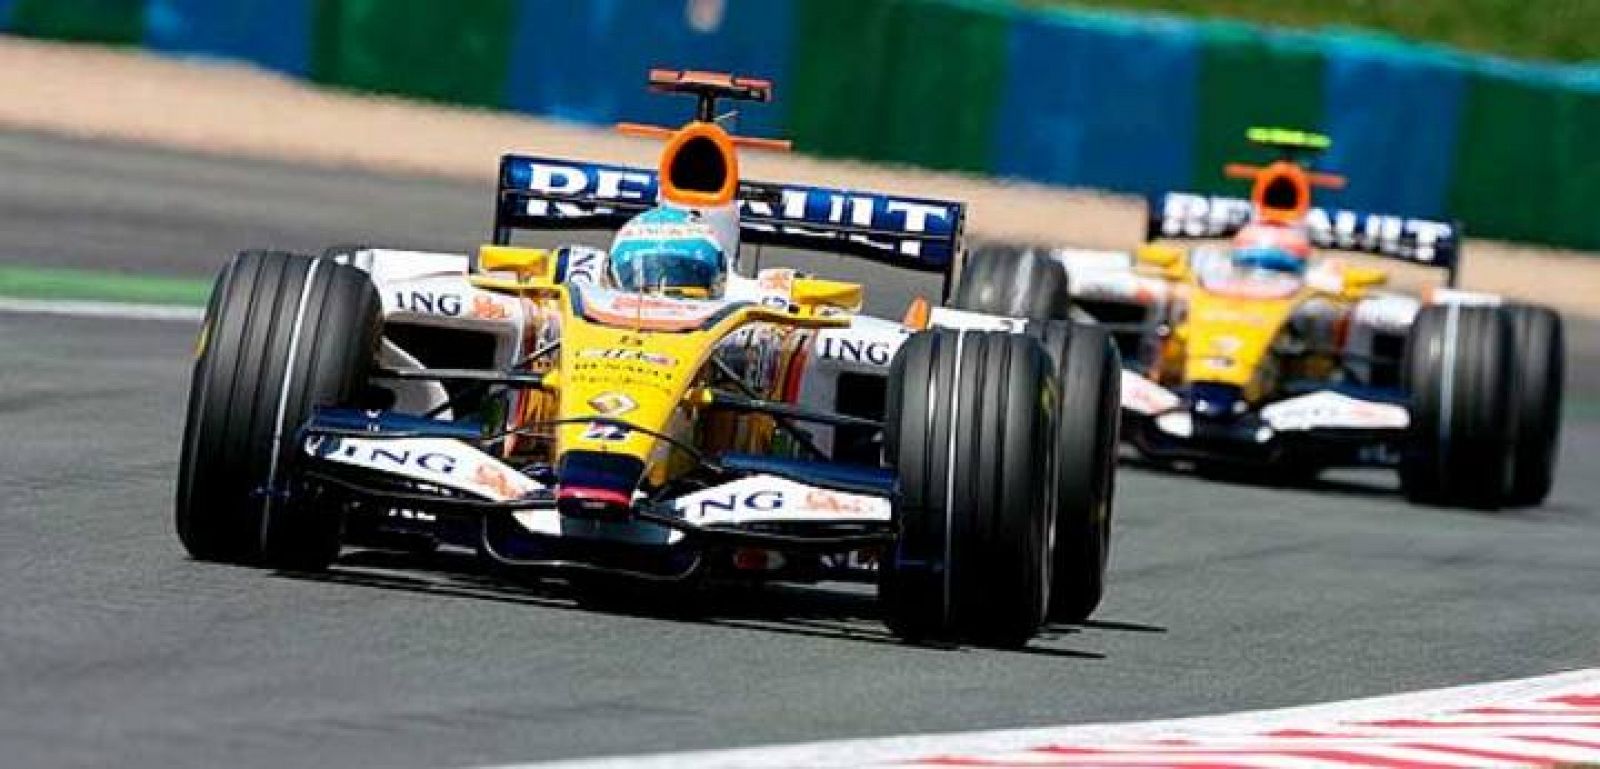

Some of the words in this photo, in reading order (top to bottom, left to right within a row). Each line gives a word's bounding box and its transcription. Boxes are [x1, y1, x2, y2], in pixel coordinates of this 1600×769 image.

[528, 162, 947, 257] REAULT
[1161, 191, 1452, 261] REAULT
[396, 290, 462, 317] ING
[821, 337, 890, 365] ING
[343, 444, 457, 475] ING
